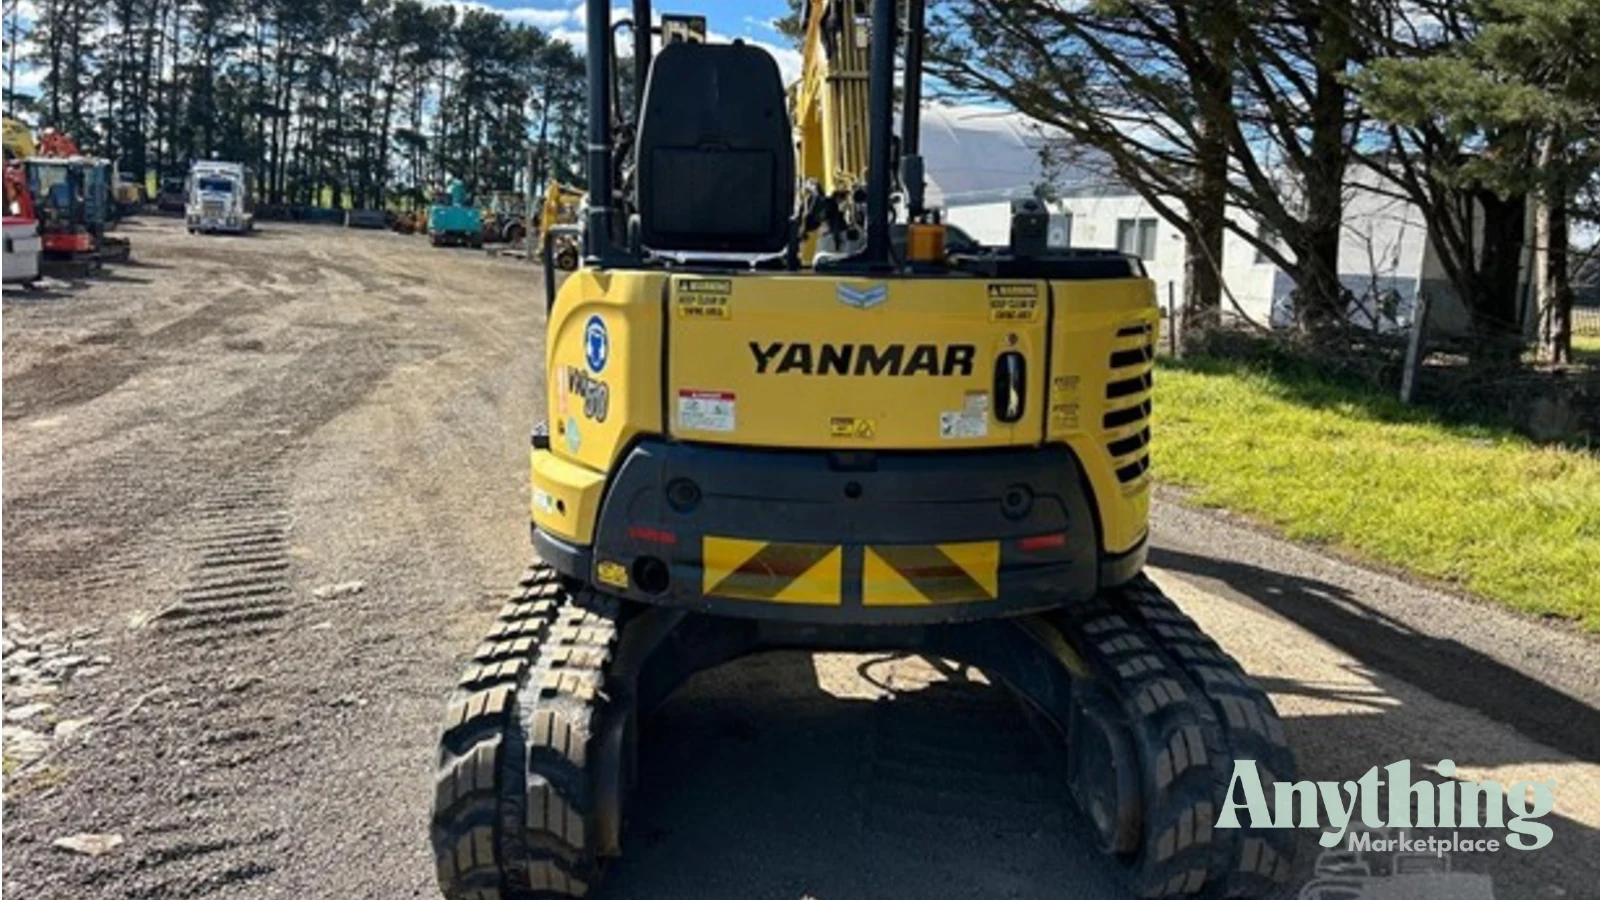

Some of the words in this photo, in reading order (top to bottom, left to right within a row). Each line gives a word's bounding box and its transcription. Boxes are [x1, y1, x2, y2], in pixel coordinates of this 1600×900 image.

[689, 281, 730, 291] WARNING
[1000, 286, 1036, 295] WARNING
[749, 341, 976, 377] YANMAR
